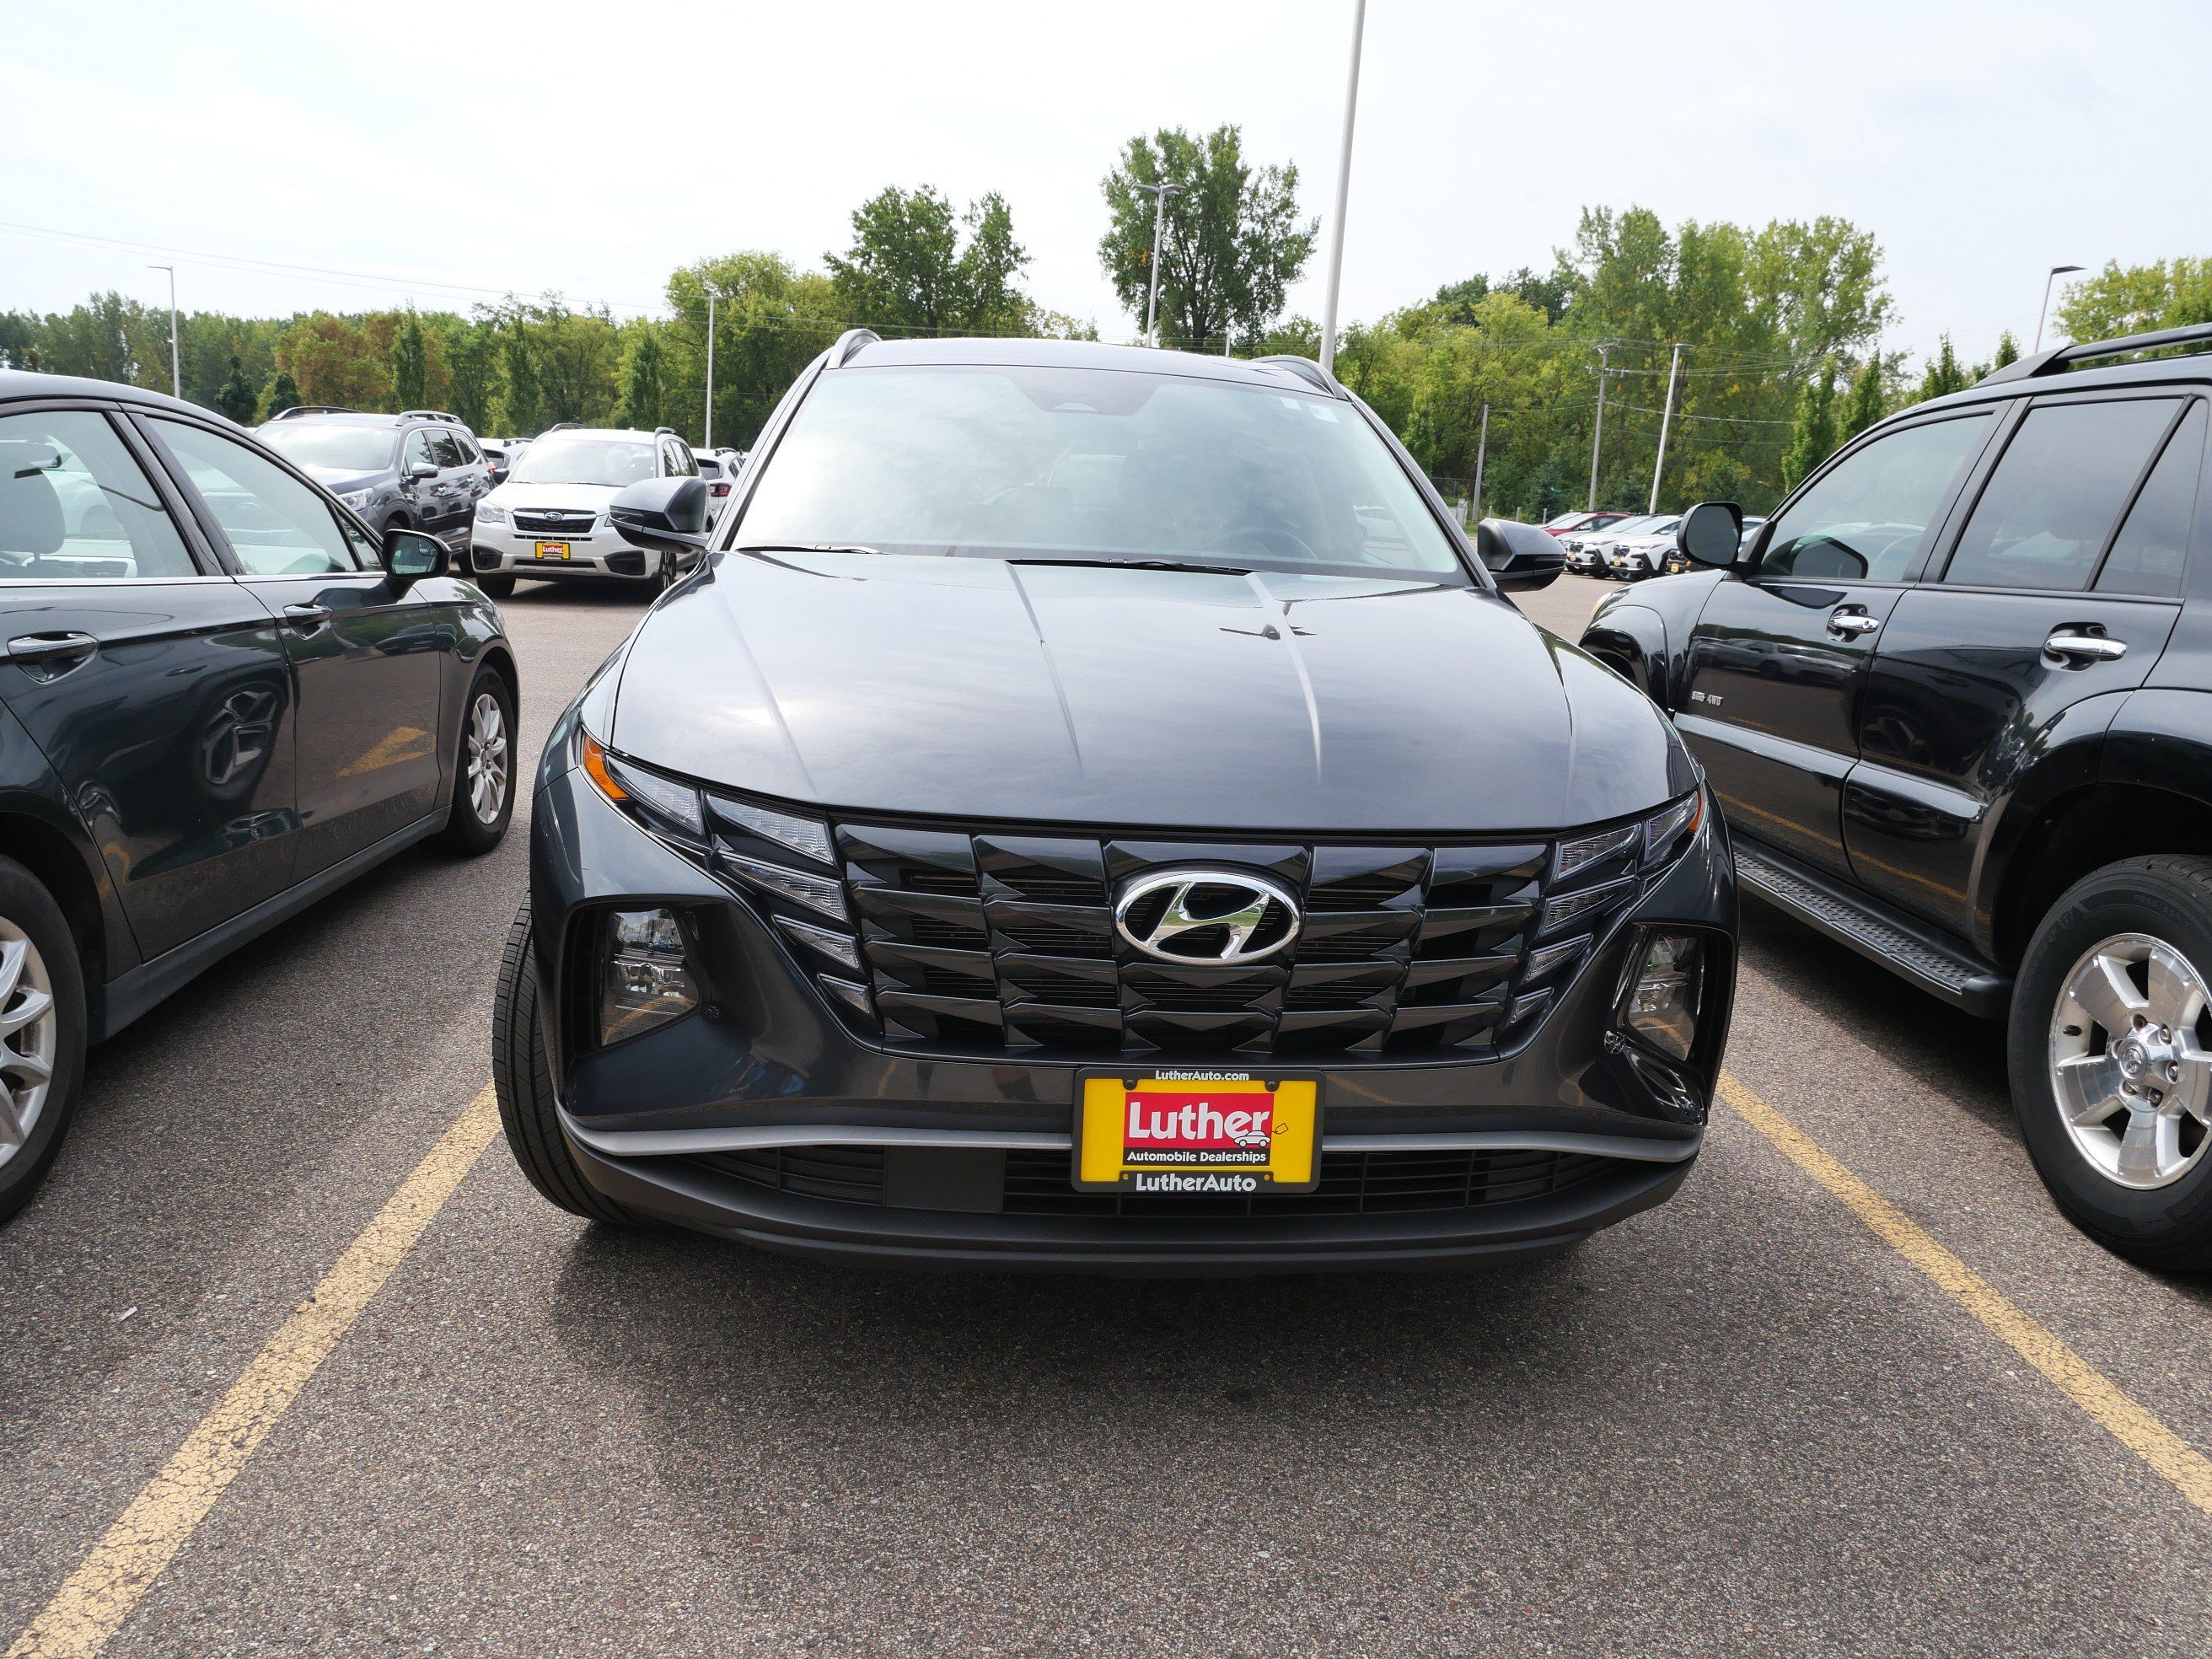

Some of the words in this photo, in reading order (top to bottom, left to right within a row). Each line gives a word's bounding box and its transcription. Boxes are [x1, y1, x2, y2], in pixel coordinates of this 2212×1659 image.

[1707, 695, 1723, 706] 4WD
[1155, 1070, 1249, 1081] LutherAuto.com
[1129, 1102, 1270, 1140] Luther
[1126, 1151, 1197, 1162] Automobile
[1200, 1151, 1266, 1163] Dealerships
[1136, 1173, 1257, 1192] LutherAuto
